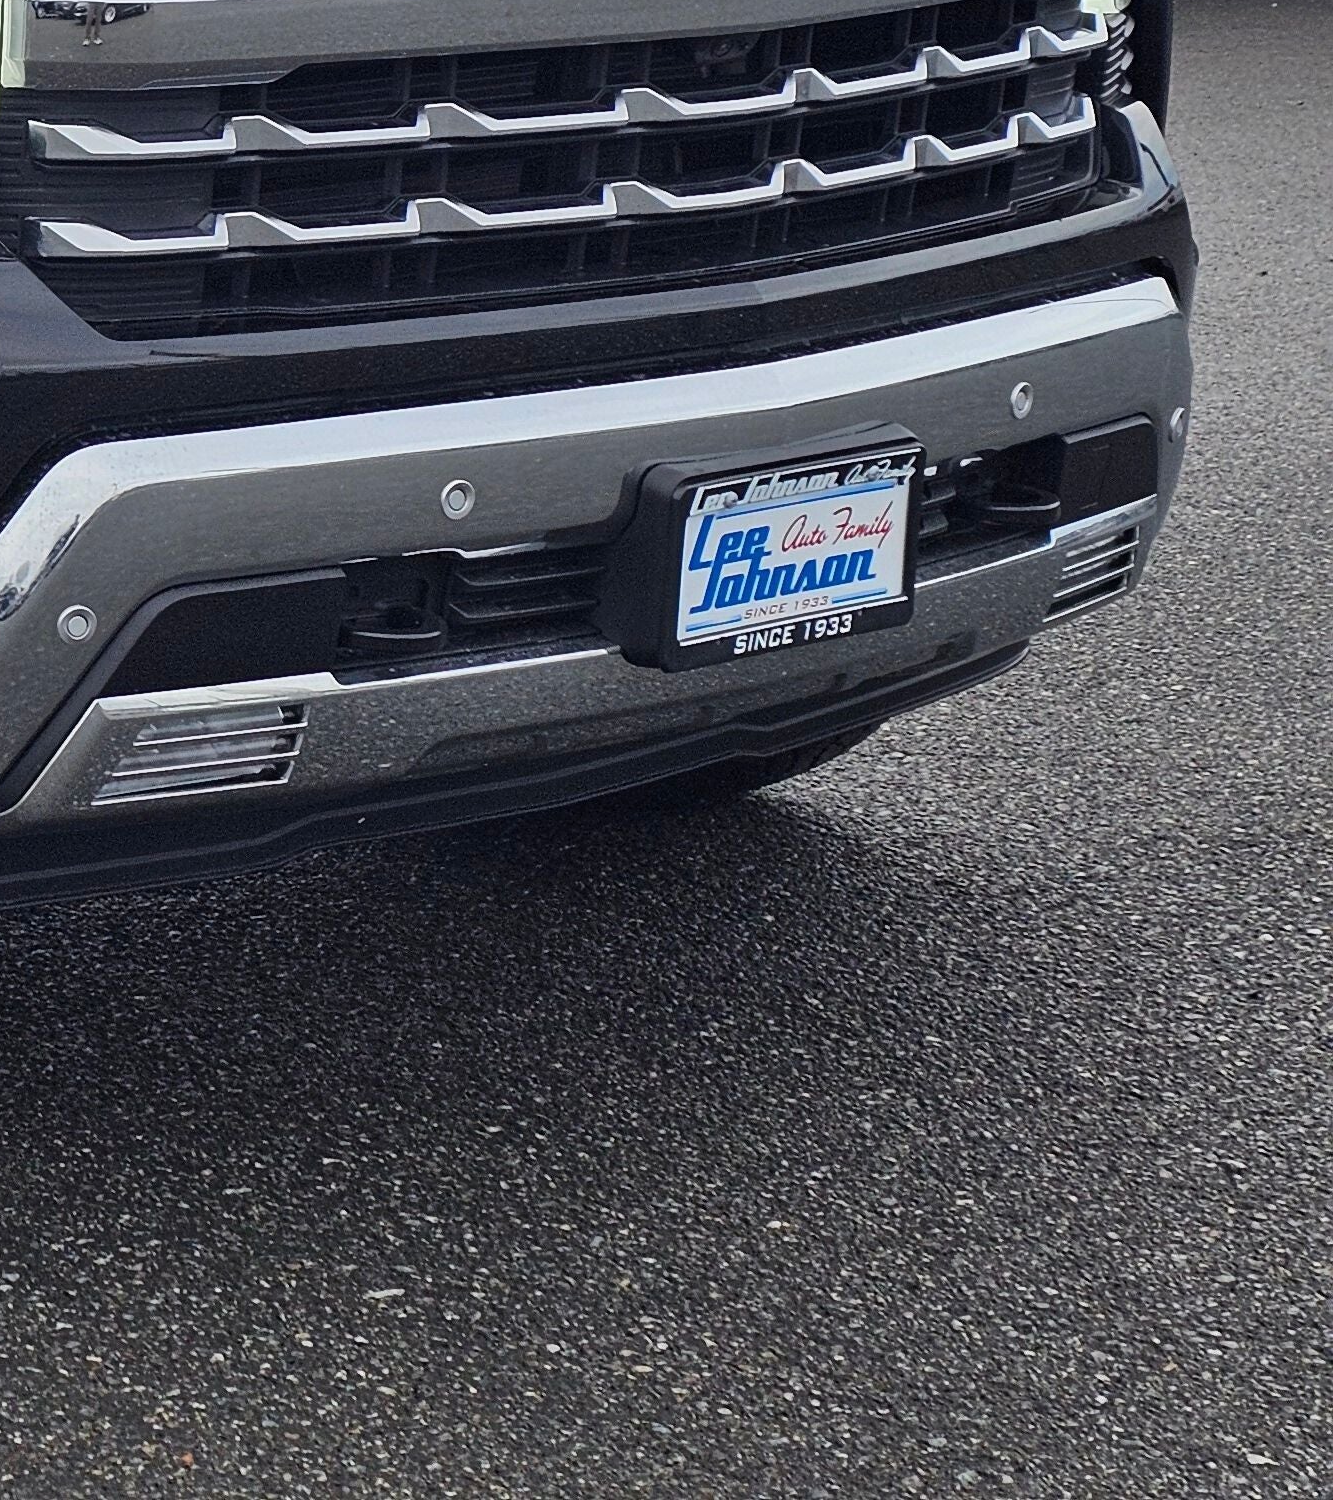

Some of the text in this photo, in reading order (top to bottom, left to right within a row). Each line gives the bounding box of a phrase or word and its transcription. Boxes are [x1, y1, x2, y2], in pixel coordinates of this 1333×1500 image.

[690, 486, 739, 516] Lee
[736, 471, 839, 504] Johnson
[689, 515, 772, 571] Lee
[782, 501, 894, 552] Auto Family
[689, 546, 876, 615] Johnson
[743, 595, 830, 620] SINCE 1933
[733, 614, 853, 655] SINCE 1933
